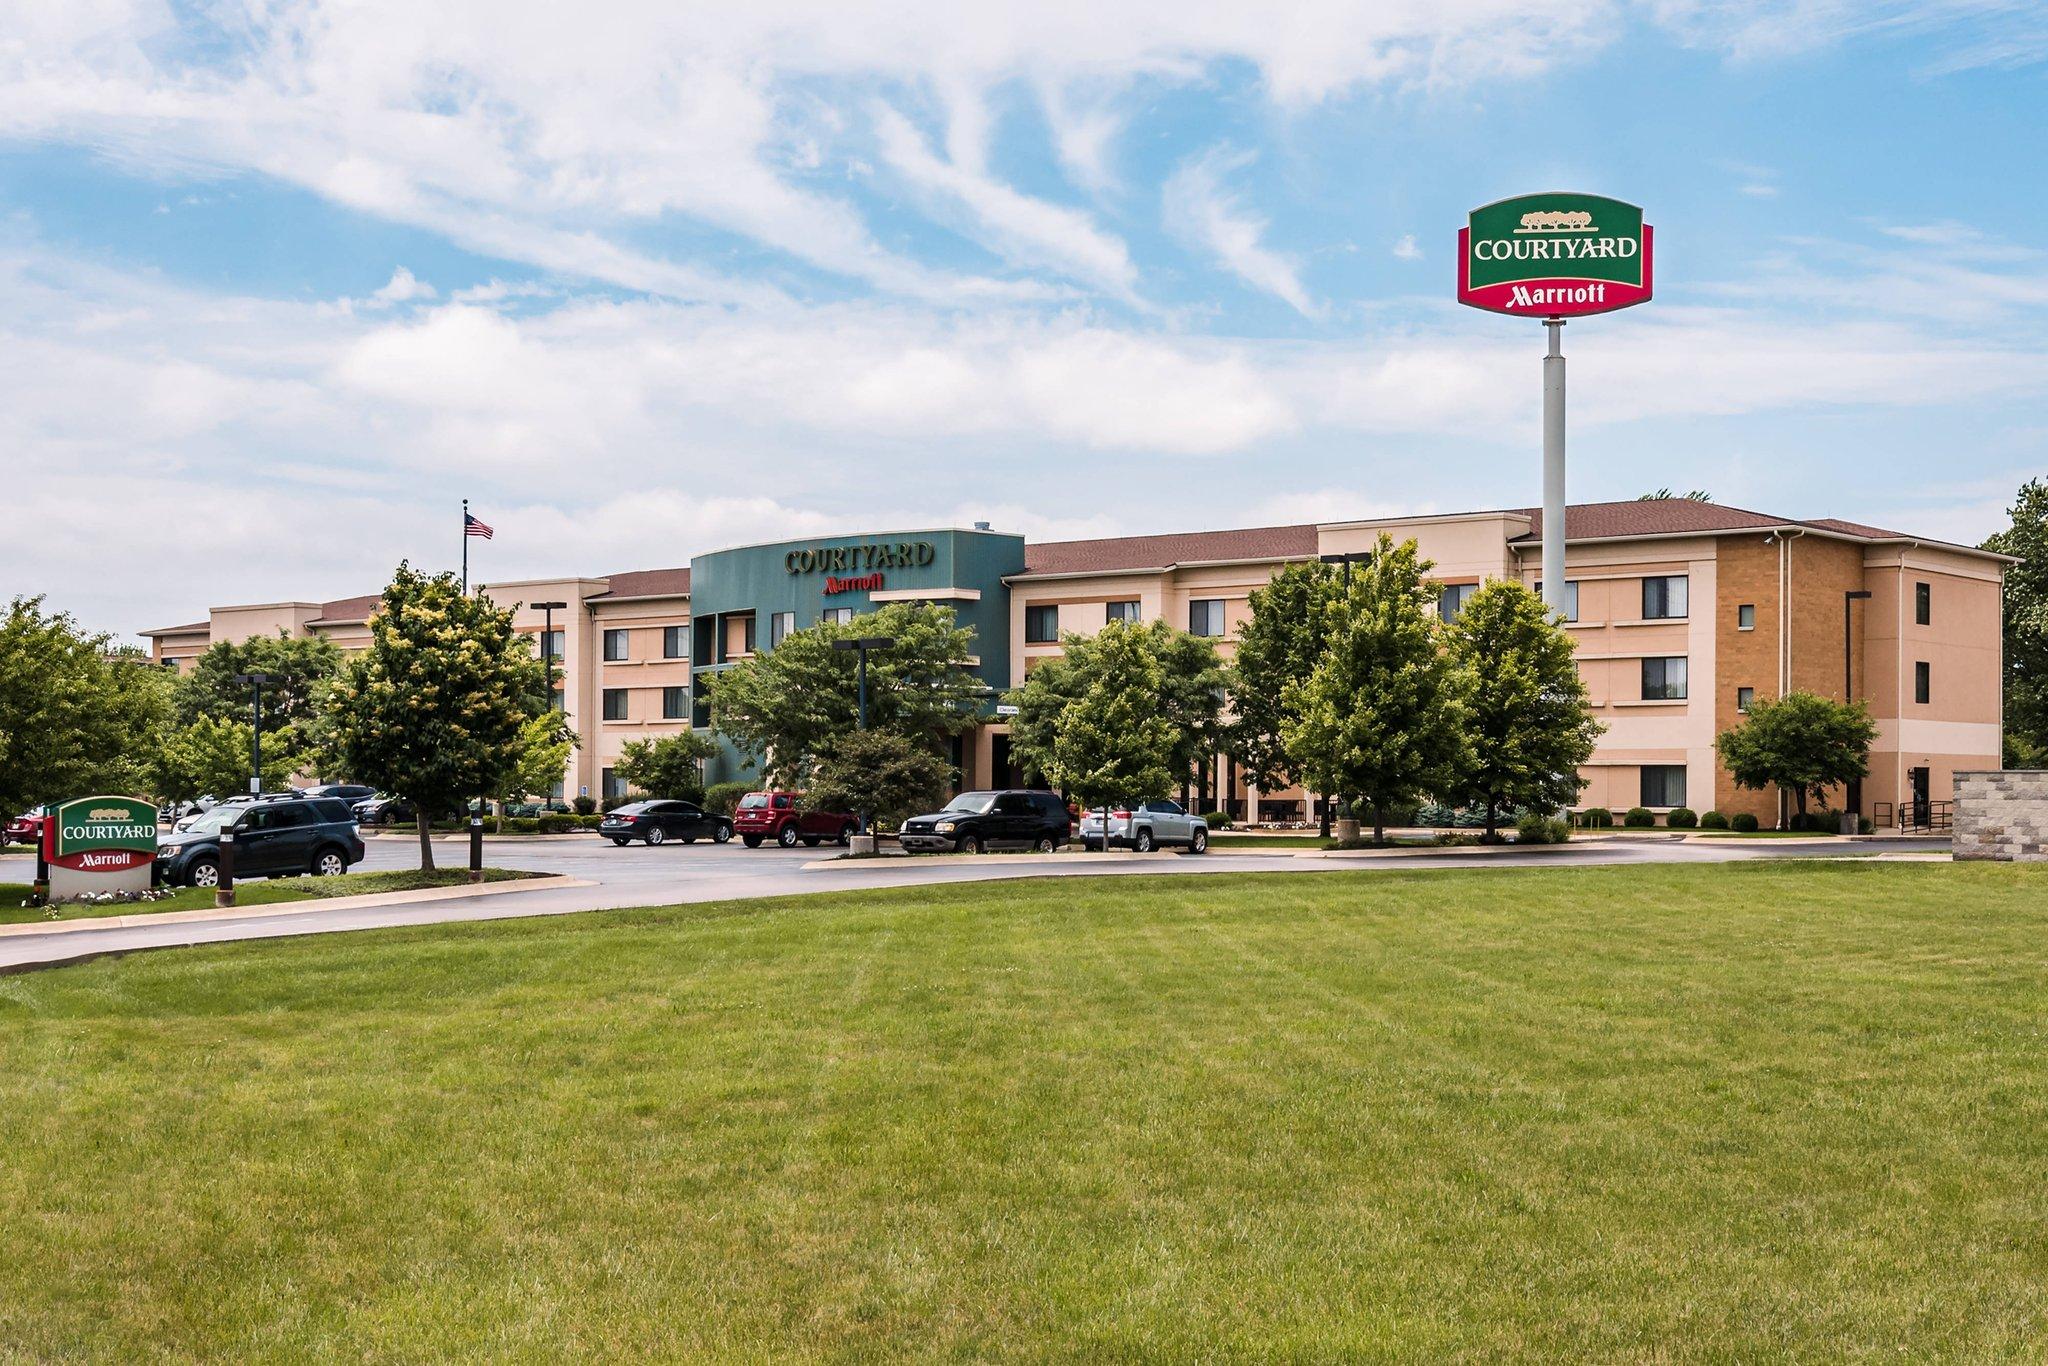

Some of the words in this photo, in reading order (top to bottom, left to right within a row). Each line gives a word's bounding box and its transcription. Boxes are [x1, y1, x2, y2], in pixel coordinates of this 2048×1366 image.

[1474, 237, 1638, 261] COURTYARD
[1505, 283, 1605, 308] Marriott
[784, 541, 935, 575] COURTYARD
[821, 572, 884, 596] Marriott
[62, 825, 156, 840] COURTYARD
[78, 853, 131, 868] Marriott
